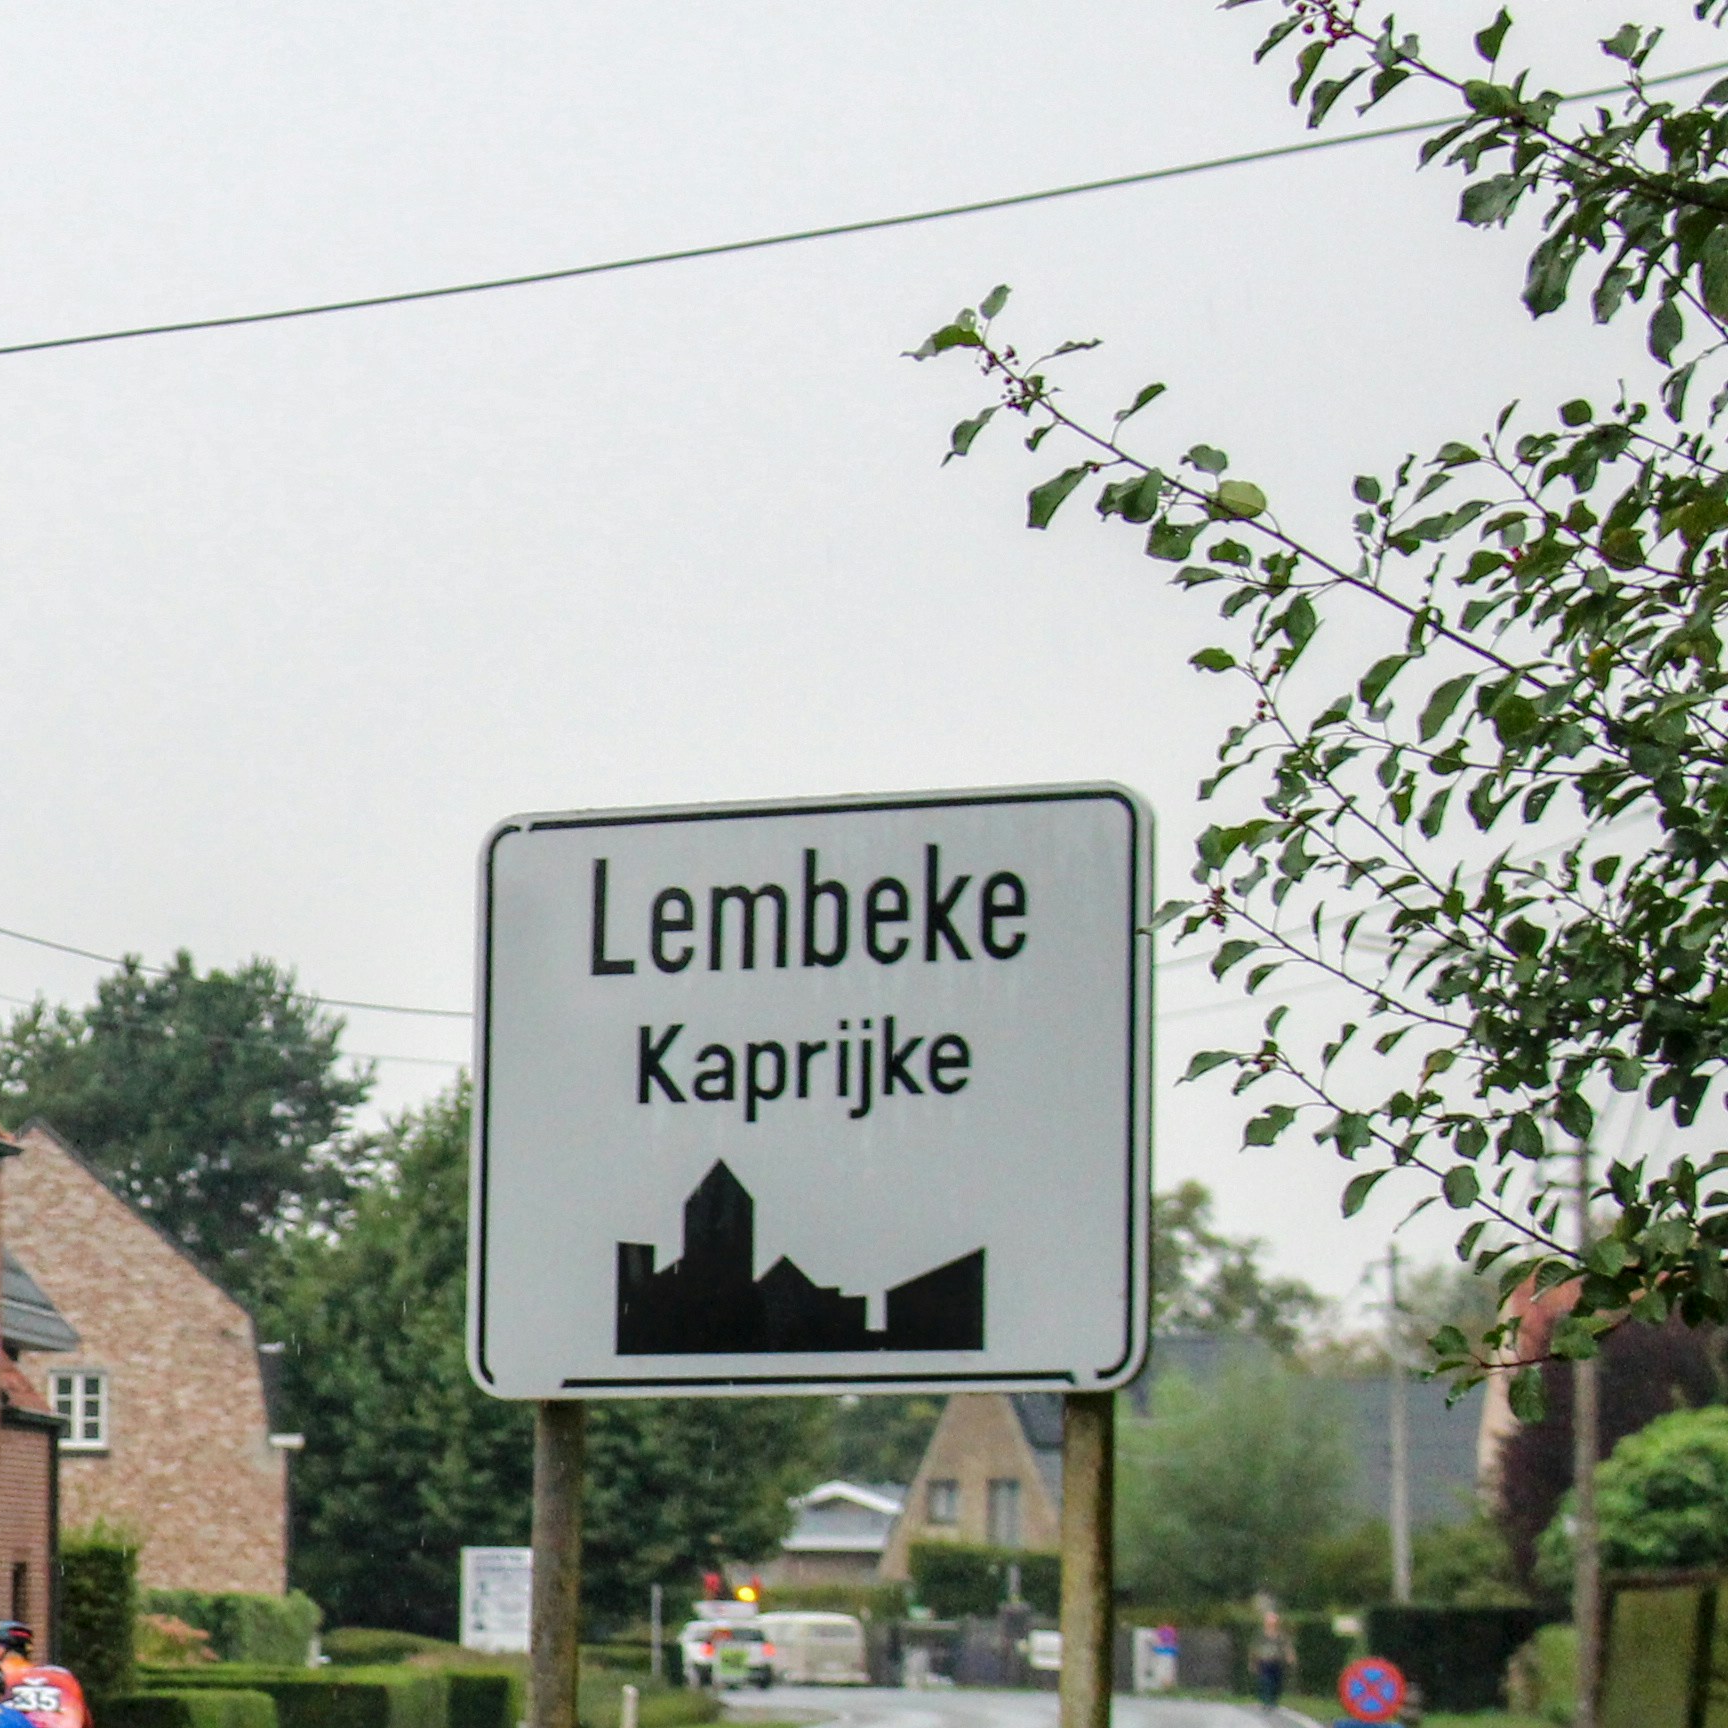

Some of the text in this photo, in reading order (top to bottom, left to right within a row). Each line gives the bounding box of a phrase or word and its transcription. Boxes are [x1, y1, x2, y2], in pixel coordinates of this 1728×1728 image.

[590, 843, 1028, 976] Lembeke
[636, 1014, 972, 1123] Kaprijke
[17, 1688, 60, 1712] 35
